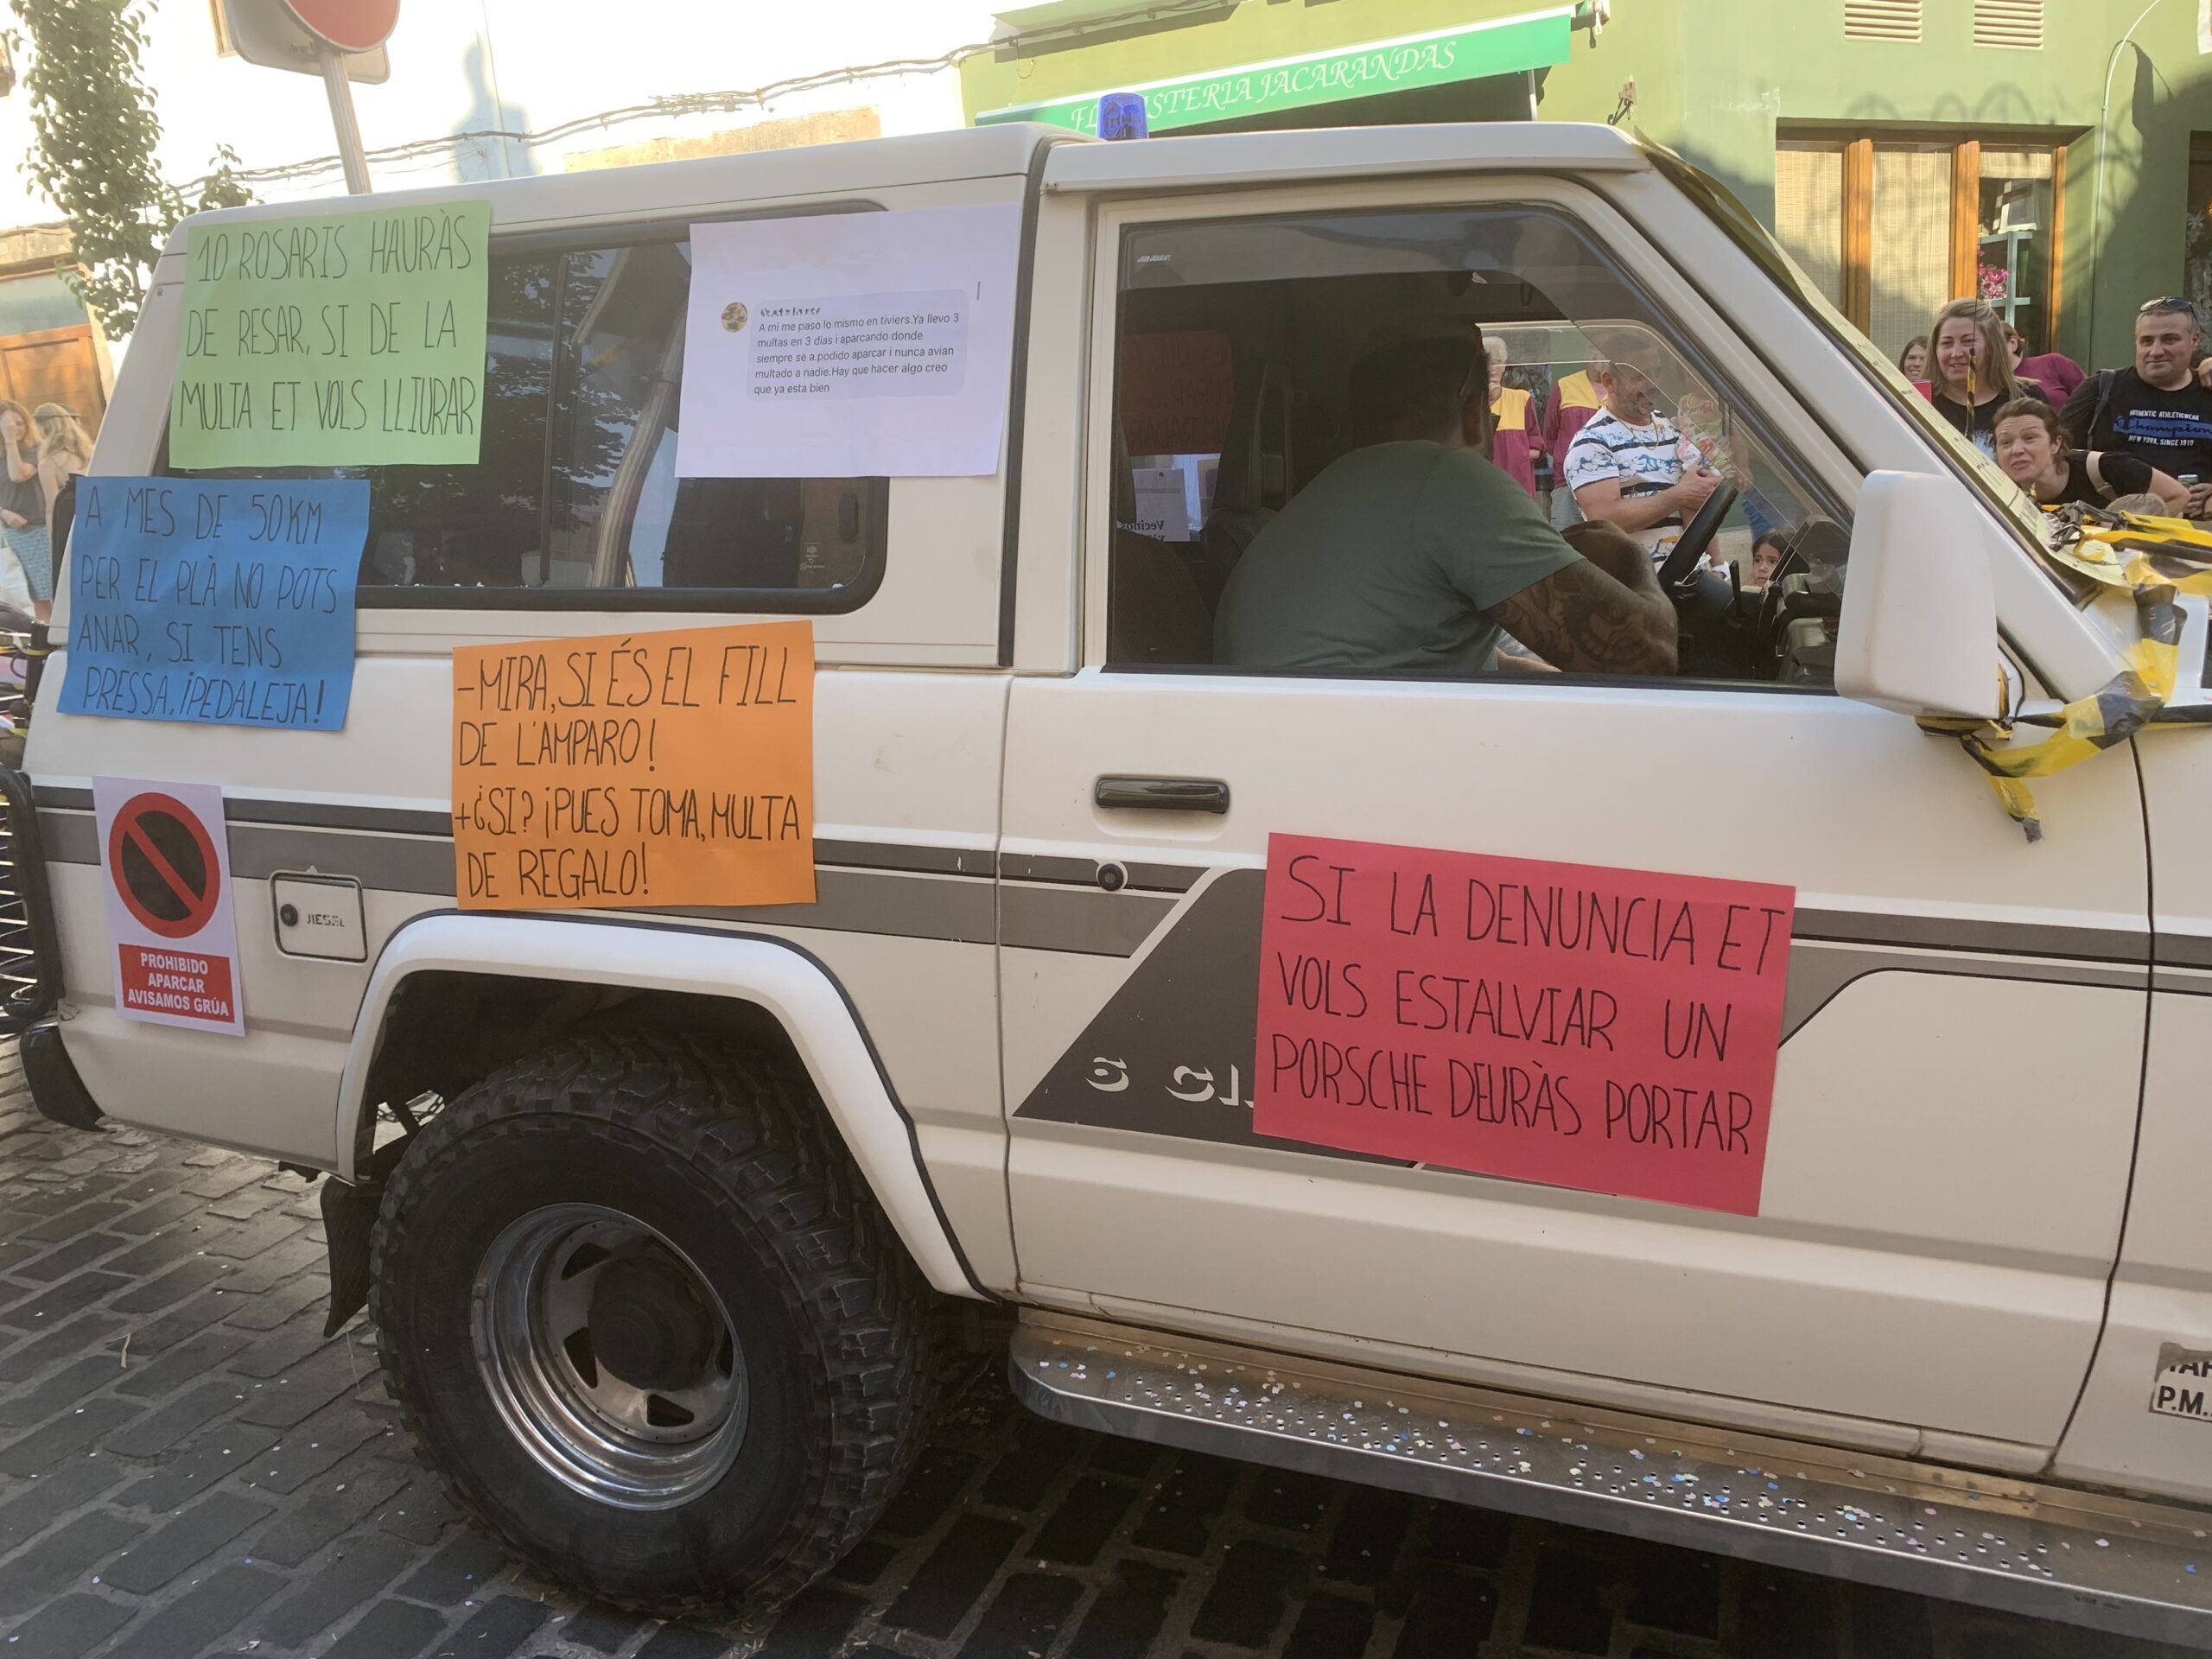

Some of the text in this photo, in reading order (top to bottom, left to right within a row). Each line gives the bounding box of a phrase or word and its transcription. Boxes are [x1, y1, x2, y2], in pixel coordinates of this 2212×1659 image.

[1255, 41, 1458, 104] JACARANDAS
[197, 209, 472, 283] 10 ROSARIS HAURÀS
[186, 299, 457, 358] DE RESAR, SI DE LA
[757, 337, 788, 347] multas
[805, 336, 811, 346] 3
[814, 336, 832, 346] dias
[840, 332, 888, 345] aparcando
[891, 331, 923, 340] donde
[759, 323, 765, 332] A
[767, 321, 779, 332] mi
[798, 321, 821, 333] paso
[823, 320, 832, 329] lo
[834, 318, 864, 328] mismo
[927, 313, 950, 323] llevo
[953, 313, 959, 322] 3
[755, 369, 792, 378] multado
[851, 367, 868, 377] que
[871, 364, 899, 373] hacer
[901, 363, 922, 375] algo
[925, 364, 947, 372] creo
[756, 353, 792, 364] siempre
[851, 348, 887, 360] aparcar
[894, 348, 925, 357] nunca
[927, 346, 954, 356] avian
[180, 376, 477, 436] MULTA ET VOLS LLIURAR
[754, 383, 830, 396] que ya esta bien
[85, 485, 103, 528] A
[124, 487, 175, 537] MES
[195, 493, 229, 540] DE
[79, 554, 338, 614] PER EL PLÀ NO POTS
[75, 613, 283, 669] ANAR, SI TENS
[607, 637, 652, 708] ÉS
[661, 646, 700, 708] EL
[719, 645, 796, 706] FILL
[460, 721, 497, 766] DE
[712, 791, 800, 840] MULTA
[467, 842, 649, 899] DE REGALO!
[1281, 855, 1786, 976] SI LA DENUNCIA ET
[141, 952, 208, 975] PROHIBIDO
[148, 972, 205, 994] APARCAR
[128, 988, 229, 1016] AVISAMOS GRÚA
[1278, 951, 1732, 1062] VOLS ESTALVIAR UN
[1272, 1033, 1753, 1154] PORSCHE DEURÀS PORTAR
